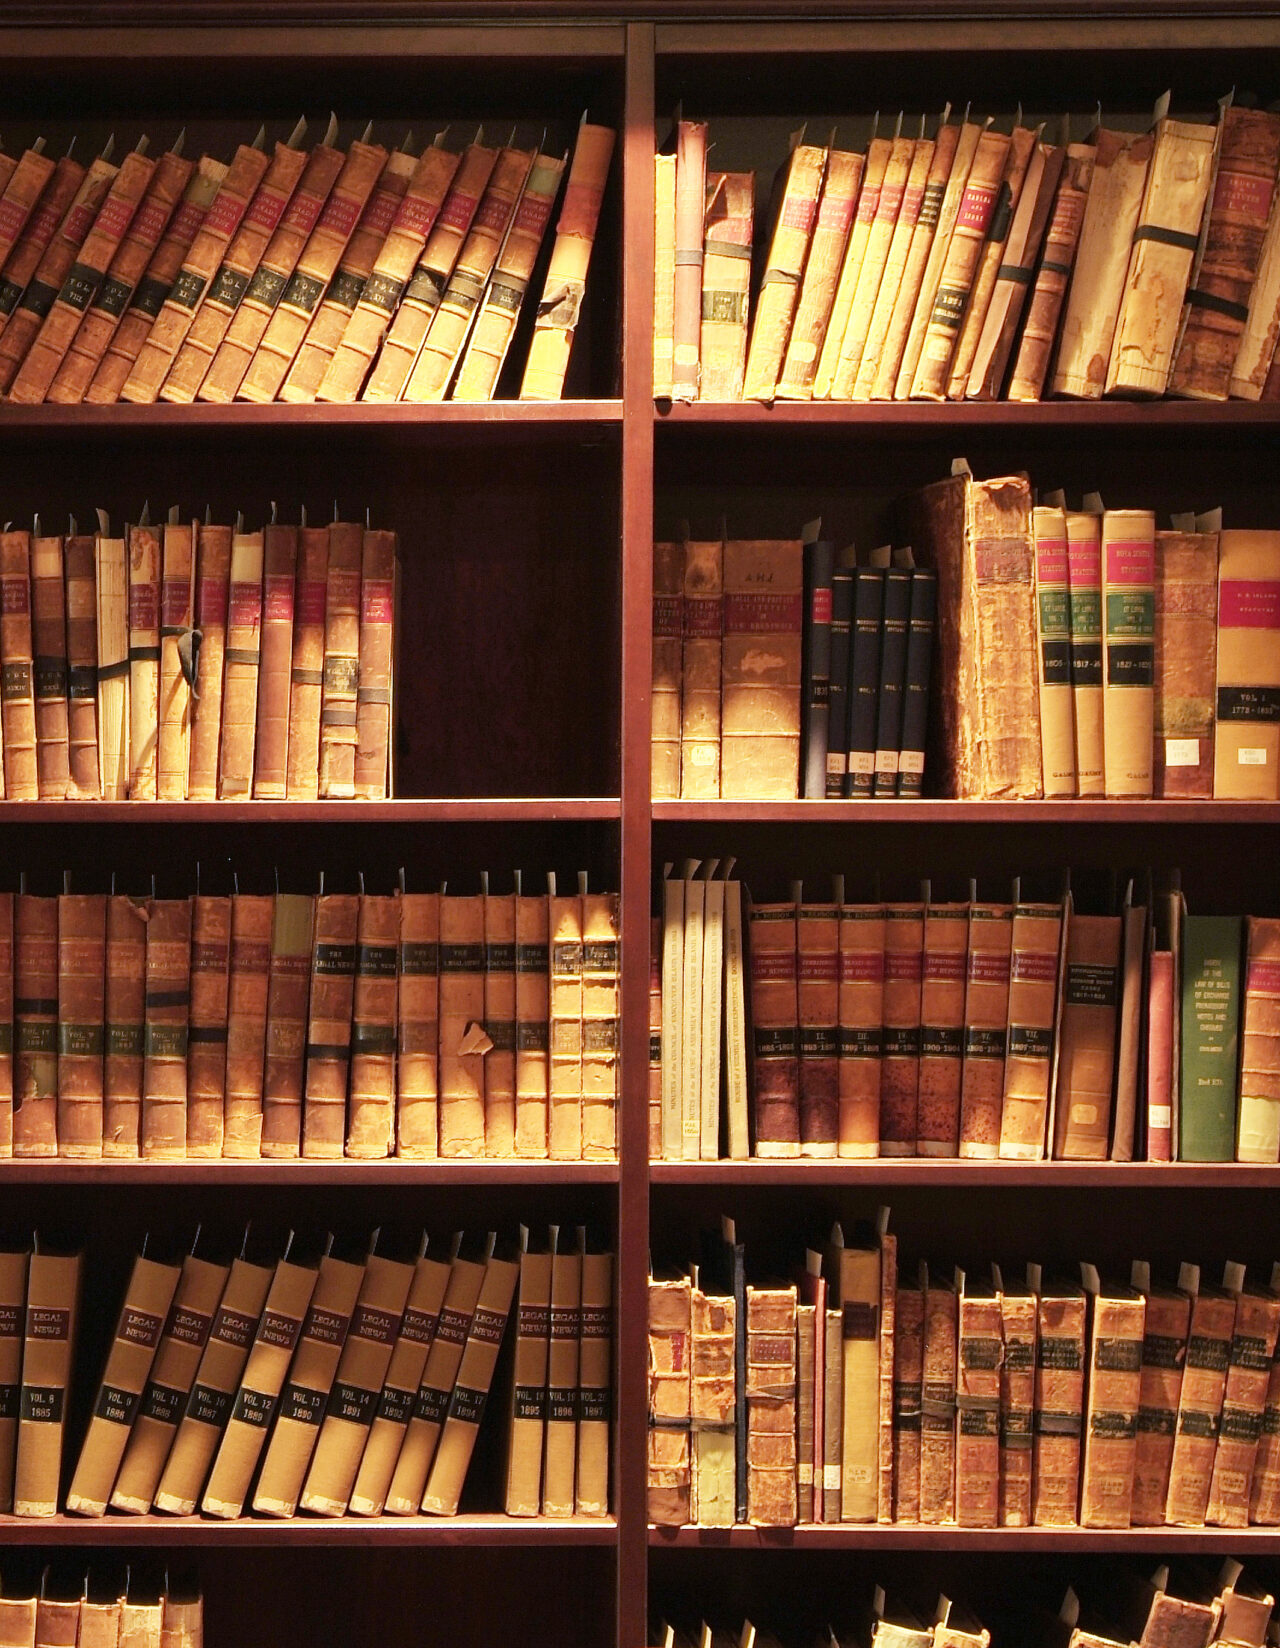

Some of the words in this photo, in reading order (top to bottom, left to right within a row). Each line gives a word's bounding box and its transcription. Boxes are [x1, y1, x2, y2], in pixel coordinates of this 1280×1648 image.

[731, 978, 739, 1037] CORRESPONDENCE
[34, 1313, 62, 1322] LEGAL
[128, 1315, 156, 1329] LEGAL
[176, 1315, 203, 1329] LEGAL
[313, 1314, 341, 1328] LEGAL
[363, 1314, 390, 1328] LEGAL
[405, 1315, 432, 1329] LEGAL
[441, 1314, 468, 1328] LEGAL
[475, 1314, 504, 1328] LEGAL
[521, 1312, 548, 1320] LEGAL
[552, 1313, 579, 1322] LEGAL
[34, 1326, 61, 1335] NEWS
[223, 1317, 249, 1331] LEGAL
[266, 1318, 294, 1333] LEGAL
[521, 1324, 547, 1333] NEWS
[126, 1328, 152, 1341] NEWS
[173, 1327, 199, 1341] NEWS
[220, 1329, 246, 1342] NEWS
[264, 1330, 290, 1345] NEWS
[311, 1327, 337, 1340] NEWS
[360, 1327, 387, 1339] NEWS
[403, 1327, 429, 1340] NEWS
[439, 1327, 464, 1340] NEWS
[474, 1326, 500, 1340] NEWS
[262, 1400, 272, 1410] 12
